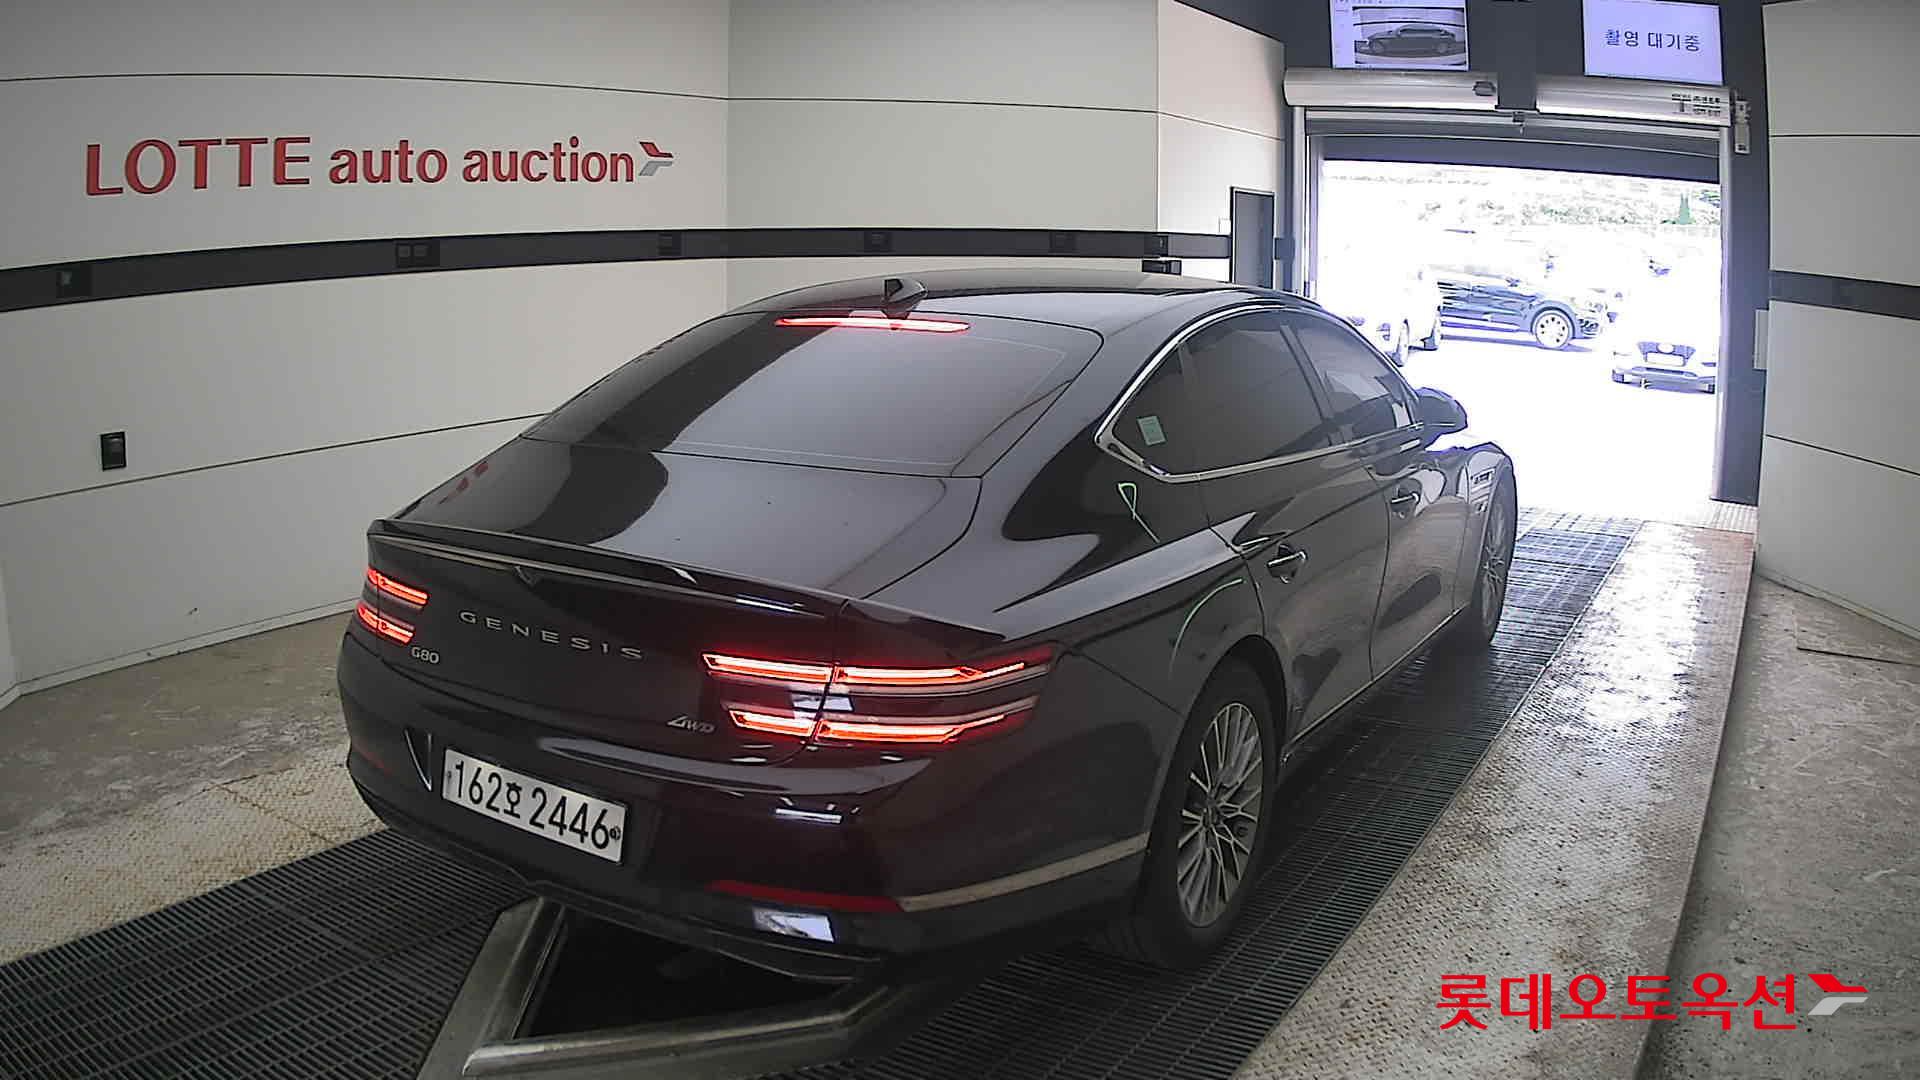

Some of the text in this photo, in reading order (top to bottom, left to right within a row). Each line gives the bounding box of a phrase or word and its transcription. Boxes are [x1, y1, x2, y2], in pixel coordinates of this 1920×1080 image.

[1647, 31, 1700, 52] 대기중
[85, 135, 635, 196] LOTTE auto auction
[411, 646, 440, 664] G80
[459, 610, 643, 660] GENESIS
[454, 760, 611, 851] 162호 2446
